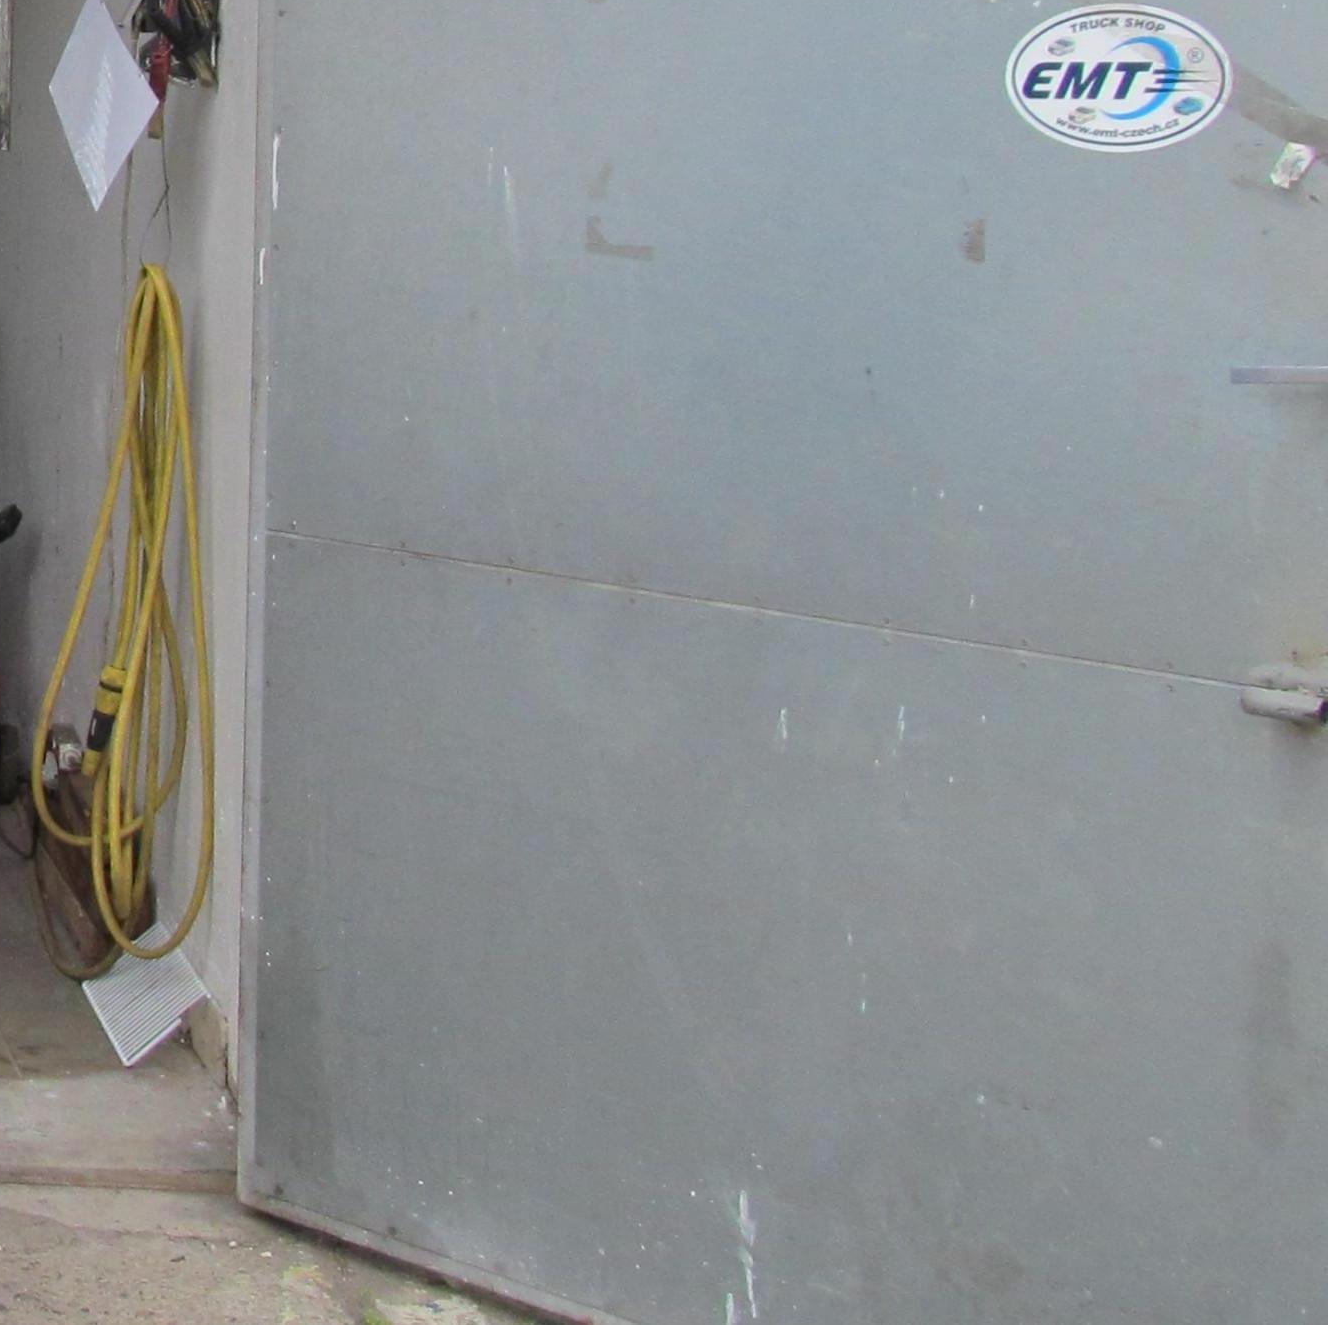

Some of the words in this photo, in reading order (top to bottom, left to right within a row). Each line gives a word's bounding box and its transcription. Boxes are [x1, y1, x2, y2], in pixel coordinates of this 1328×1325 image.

[1069, 18, 1120, 34] TRUCK
[1124, 18, 1166, 33] SHOP
[1021, 61, 1153, 100] EMT
